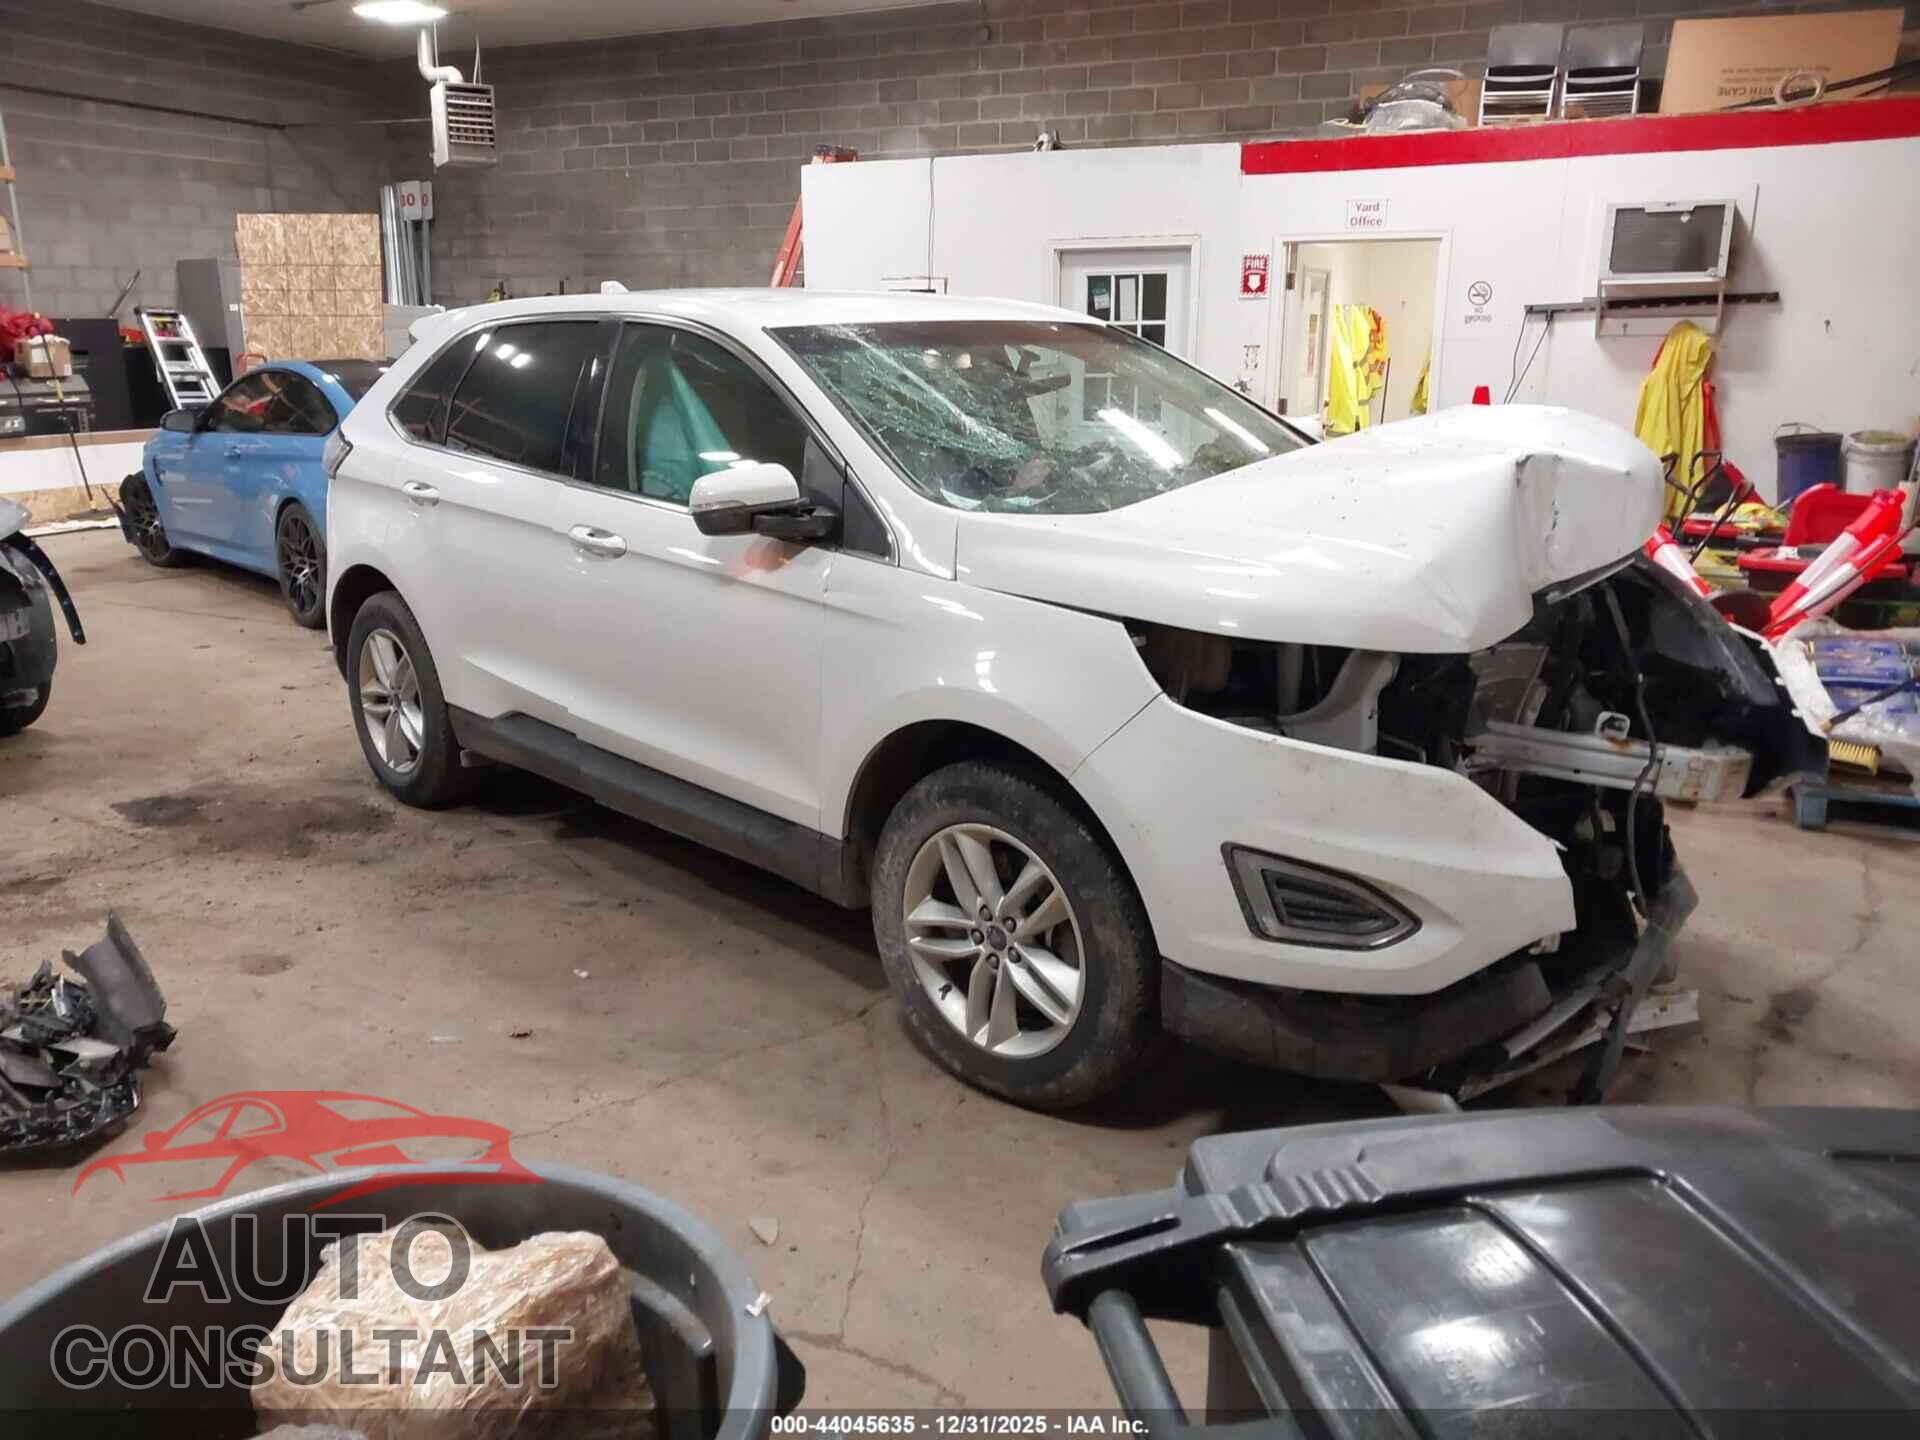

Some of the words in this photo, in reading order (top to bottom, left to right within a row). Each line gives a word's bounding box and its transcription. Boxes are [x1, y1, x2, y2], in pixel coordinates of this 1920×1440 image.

[1355, 201, 1380, 212] Yard
[1350, 216, 1382, 226] Office
[1247, 259, 1266, 269] FIRE
